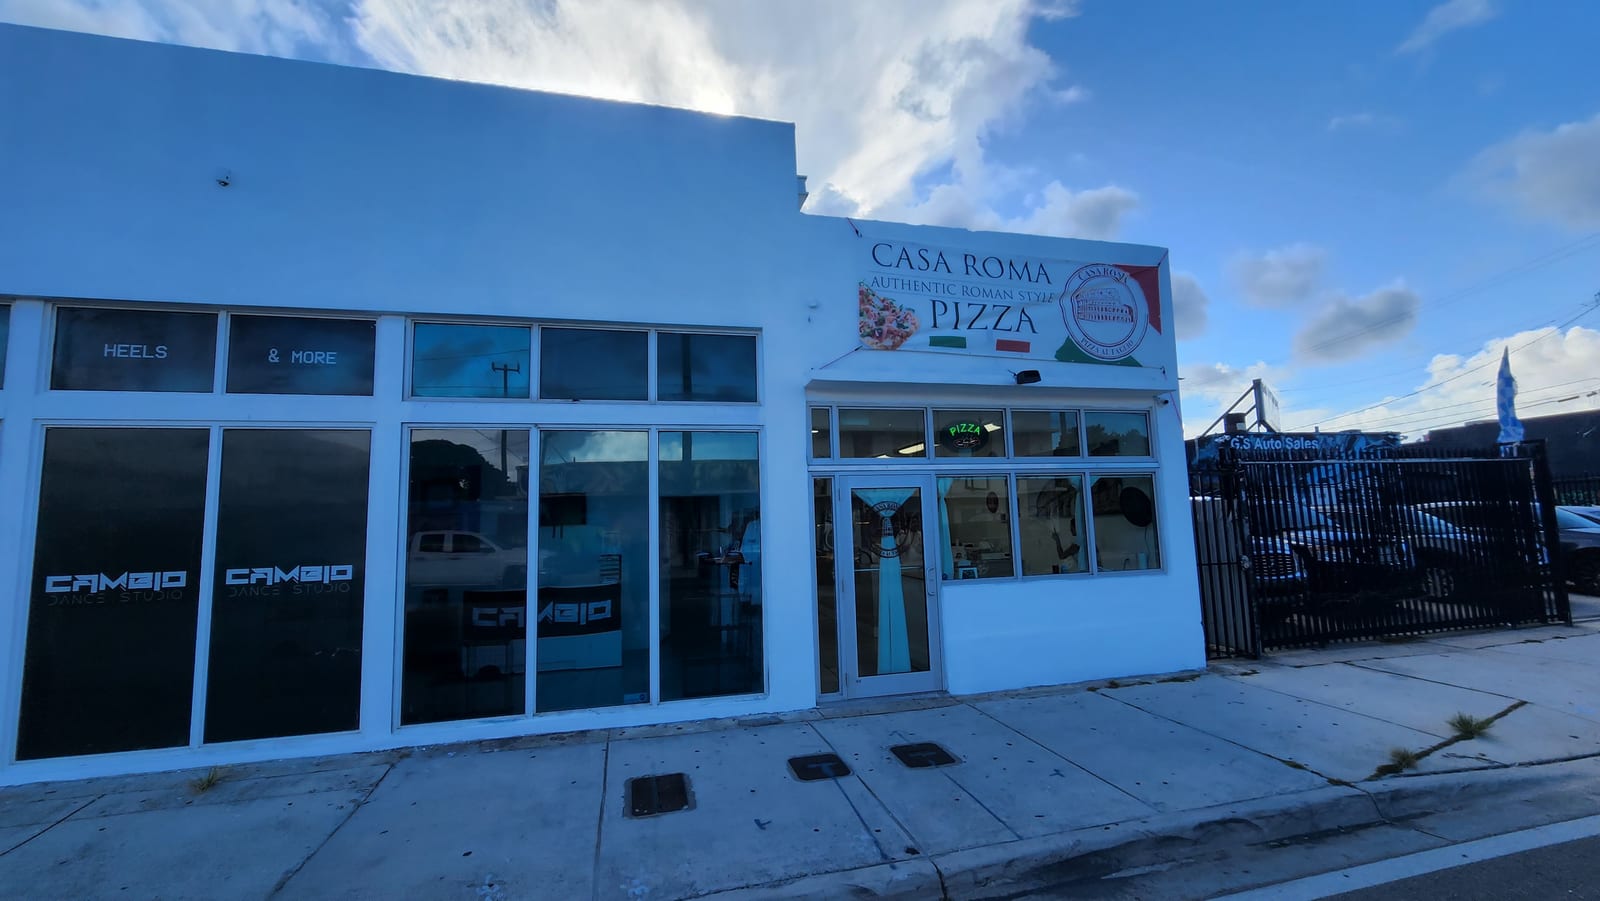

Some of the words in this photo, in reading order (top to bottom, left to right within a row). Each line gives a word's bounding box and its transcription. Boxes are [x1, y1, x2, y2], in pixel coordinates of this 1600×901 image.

[872, 242, 952, 274] CASA
[964, 253, 1053, 285] ROMA
[871, 276, 956, 296] AUTHENTIC
[961, 285, 1014, 301] ROMAN
[1019, 290, 1054, 304] STYLE
[931, 299, 1039, 334] PIZZA
[103, 343, 168, 359] HEELS
[268, 348, 280, 363] &
[291, 351, 337, 365] MORE
[949, 424, 981, 436] PIZZA
[1254, 438, 1281, 449] Auto
[1285, 437, 1319, 449] Sales
[45, 570, 187, 593] CAMBIO
[225, 565, 353, 586] CAMBIO
